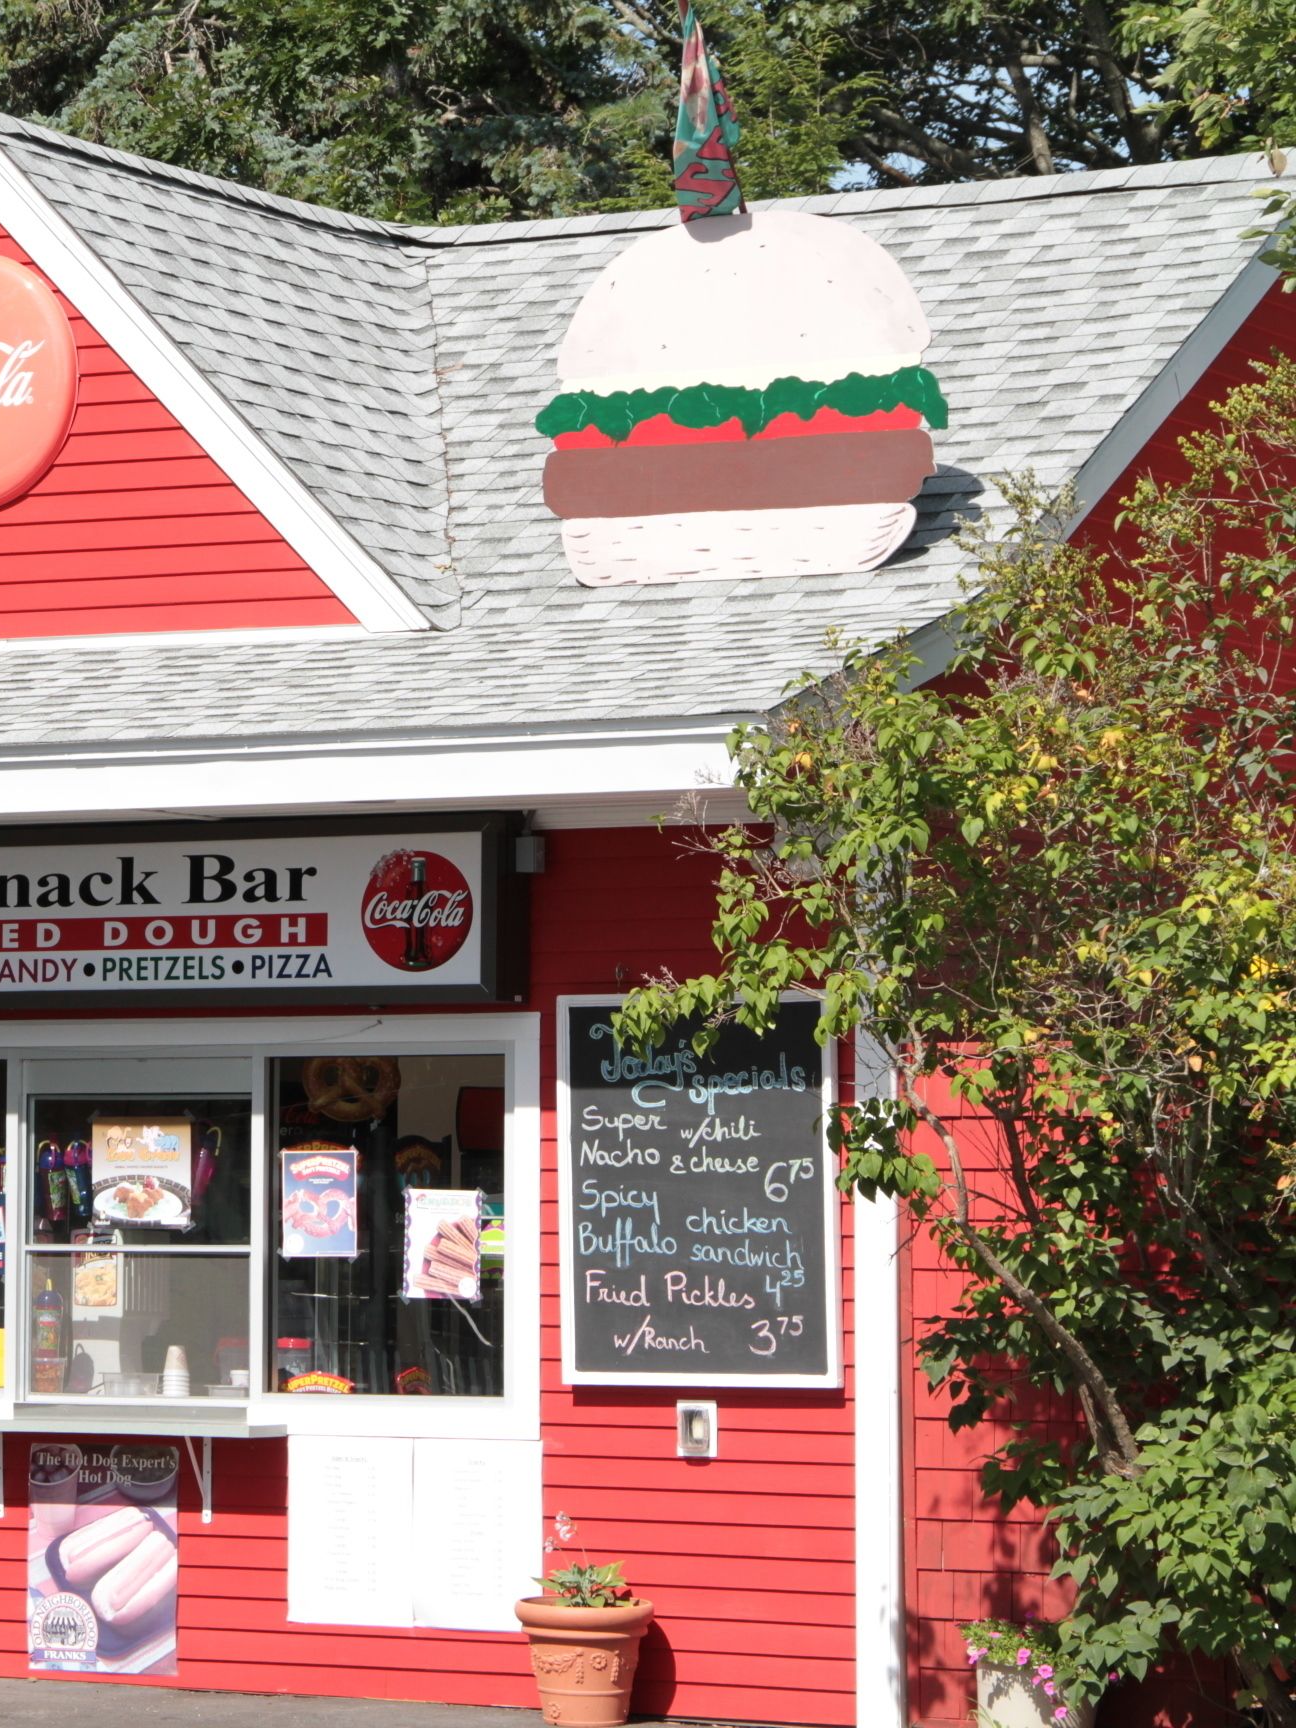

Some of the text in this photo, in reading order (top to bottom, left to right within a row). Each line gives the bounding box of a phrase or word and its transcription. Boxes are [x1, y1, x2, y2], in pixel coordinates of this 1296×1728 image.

[182, 853, 318, 904] Bar
[363, 889, 470, 930] Coca-Cola
[105, 916, 307, 947] DOUGH
[103, 956, 225, 982] PRETZELS
[251, 954, 333, 979] PIZZA
[689, 1052, 806, 1115] specials
[581, 1105, 668, 1141] Super
[580, 1139, 660, 1168] Nacho
[579, 1178, 793, 1235] Spicy chicken
[578, 1217, 805, 1270] Buffalo sandwich
[585, 1270, 756, 1309] Fried Pickles
[613, 1315, 710, 1356] w/Ranch
[37, 1452, 176, 1473] The Hot Dog Expert's
[78, 1469, 132, 1488] Hot Dog
[36, 1594, 96, 1648] NEIGHBORHOOD
[44, 1650, 86, 1660] FRANKS
